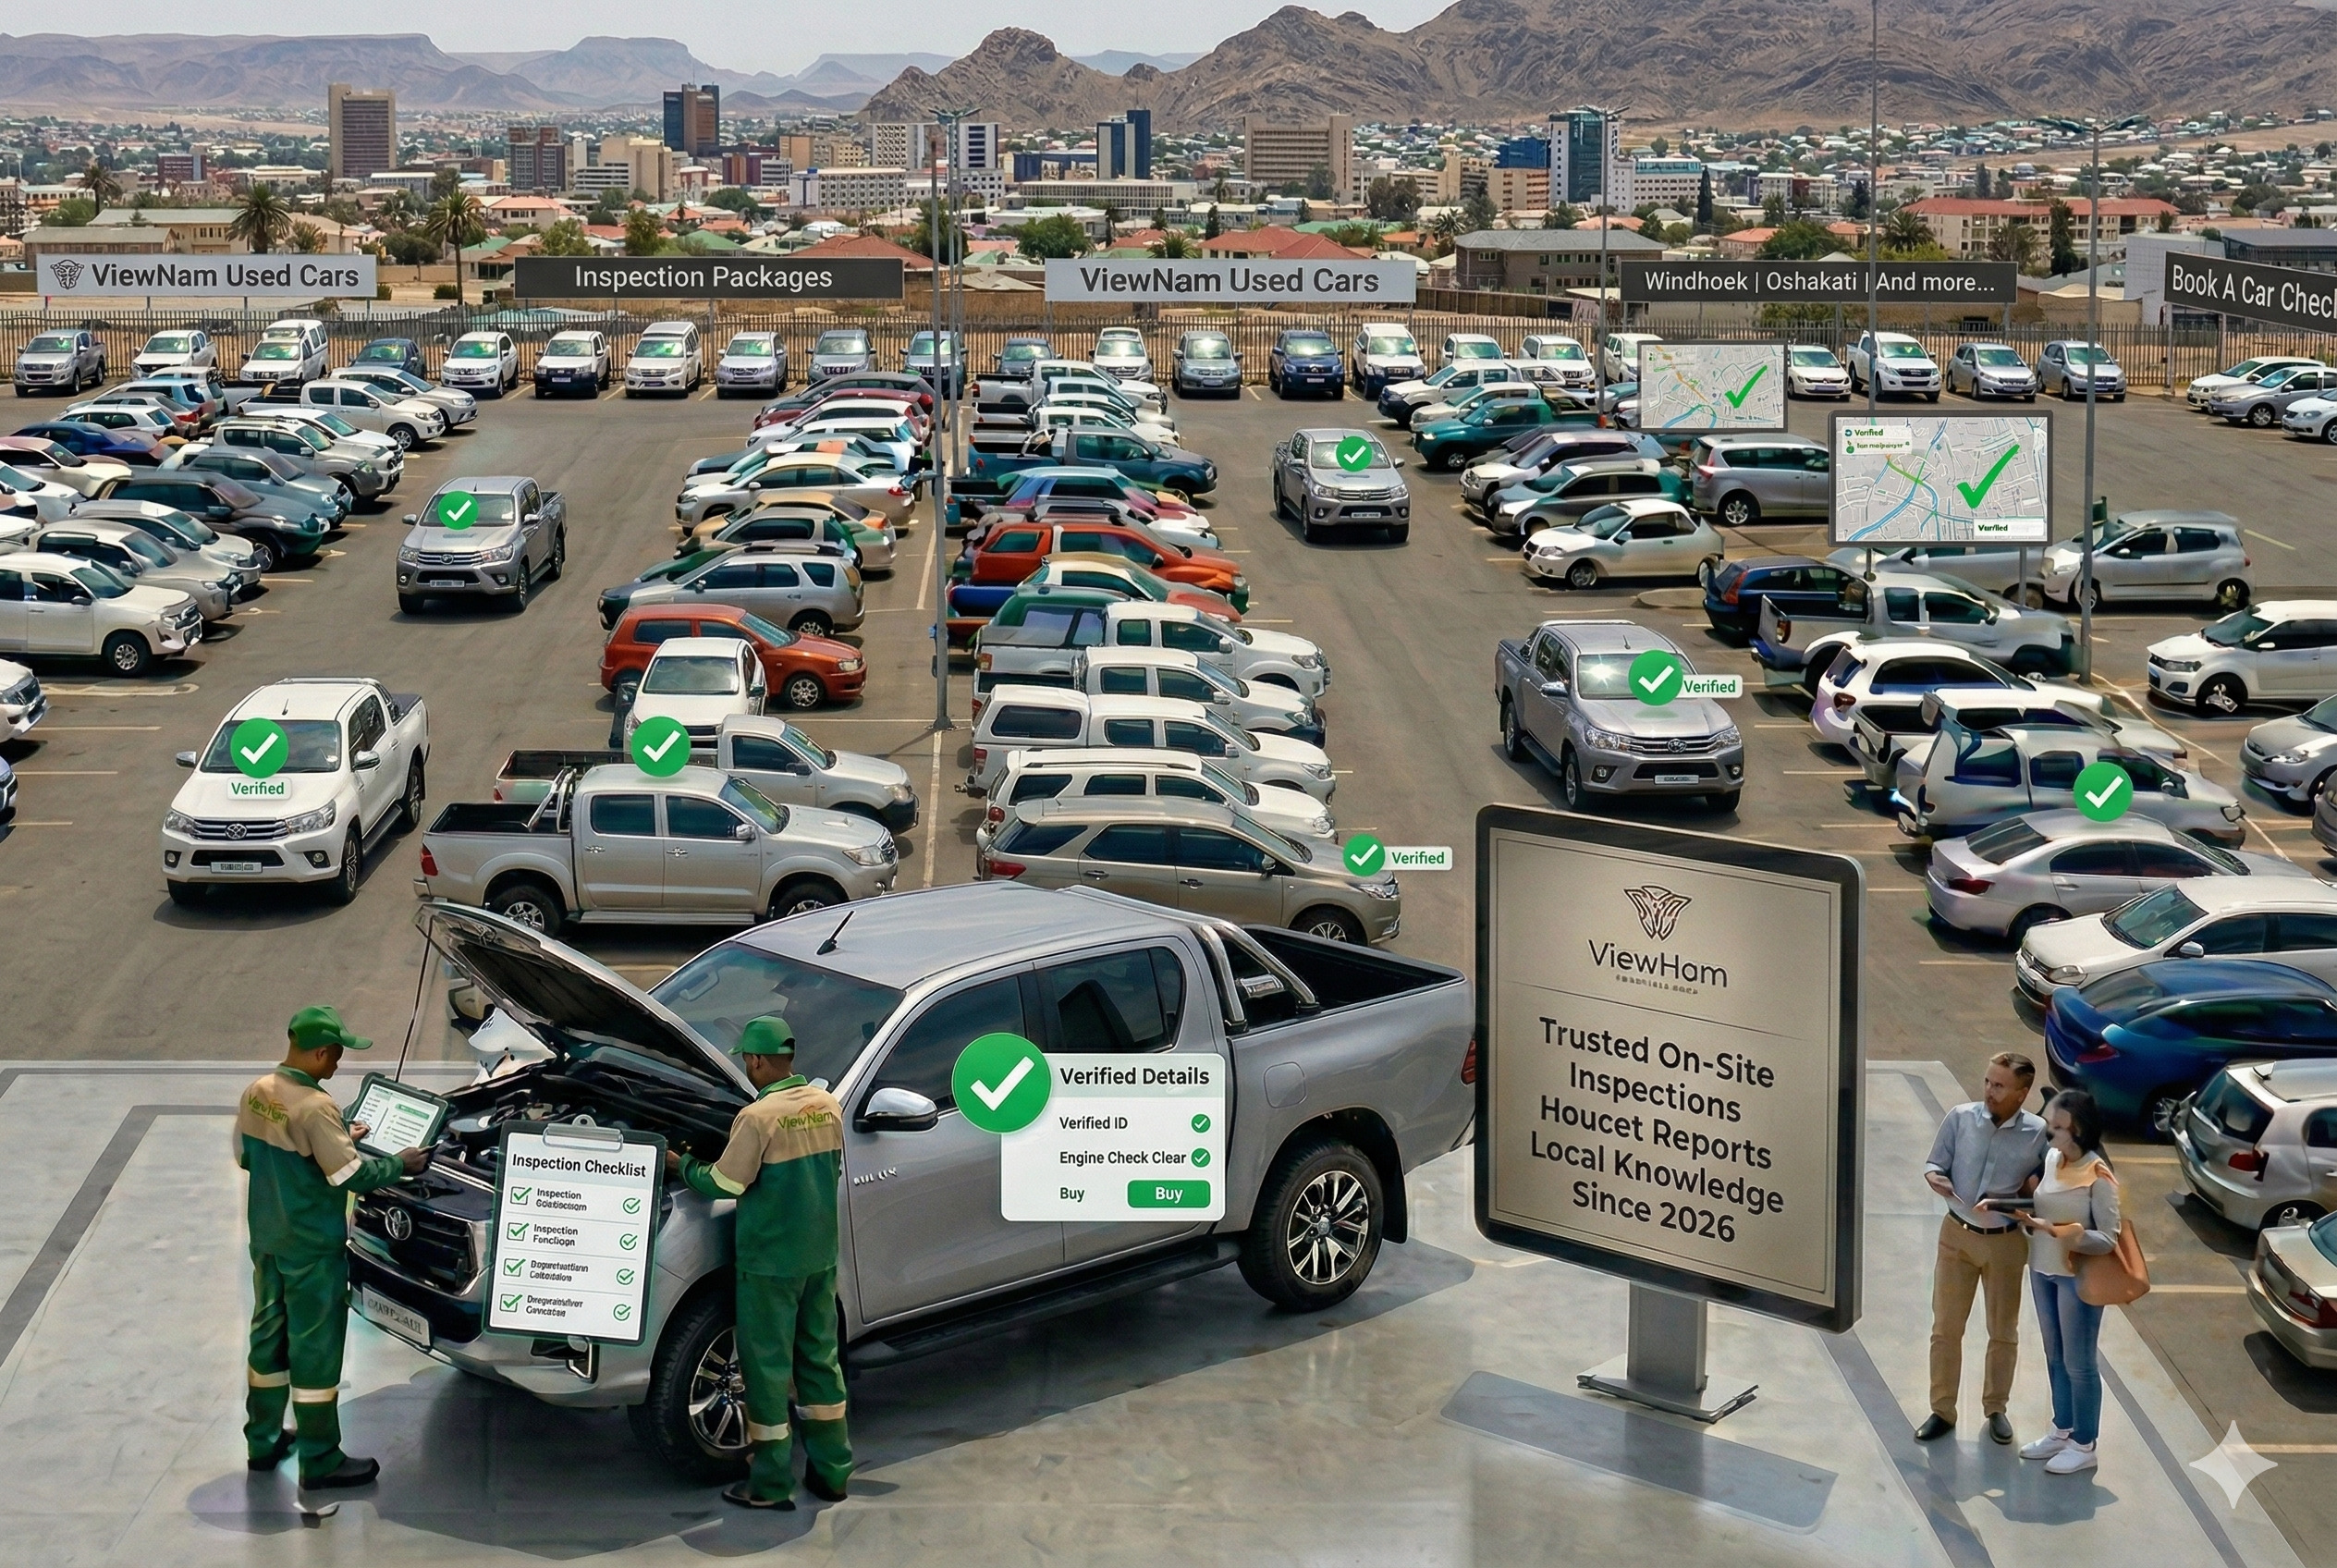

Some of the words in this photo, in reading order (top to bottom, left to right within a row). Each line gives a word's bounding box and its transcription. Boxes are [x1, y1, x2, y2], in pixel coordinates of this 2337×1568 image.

[92, 263, 217, 287] ViewNam
[226, 263, 291, 287] Used
[300, 263, 360, 287] Cars
[575, 265, 704, 293] Inspection
[713, 264, 833, 293] Packages
[1079, 267, 1221, 293] ViewNam
[1230, 267, 1303, 292] Used
[1313, 268, 1380, 292] Cars
[1645, 271, 1748, 290] Windhoek
[1766, 271, 1857, 290] Oshakati
[1875, 272, 1916, 291] And
[1922, 275, 1996, 292] more...
[2172, 264, 2218, 299] Book
[2221, 273, 2236, 301] A
[2242, 276, 2275, 308] Car
[2281, 282, 2337, 319] Chec
[1588, 938, 1728, 988] ViewHam
[1539, 1016, 1649, 1064] Trusted
[1658, 1042, 1775, 1088] On-Site
[1570, 1061, 1742, 1123] Inspections
[1540, 1095, 1644, 1142] Houcet
[1653, 1118, 1772, 1170] Reports
[512, 1154, 581, 1171] Inspection
[584, 1159, 646, 1177] Checklist
[1531, 1130, 1604, 1172] Local
[1614, 1149, 1784, 1216] Knowledge
[537, 1188, 581, 1200] Inspection
[1572, 1180, 1652, 1222] Since
[1659, 1201, 1735, 1243] 2026
[533, 1224, 578, 1235] Inspection
